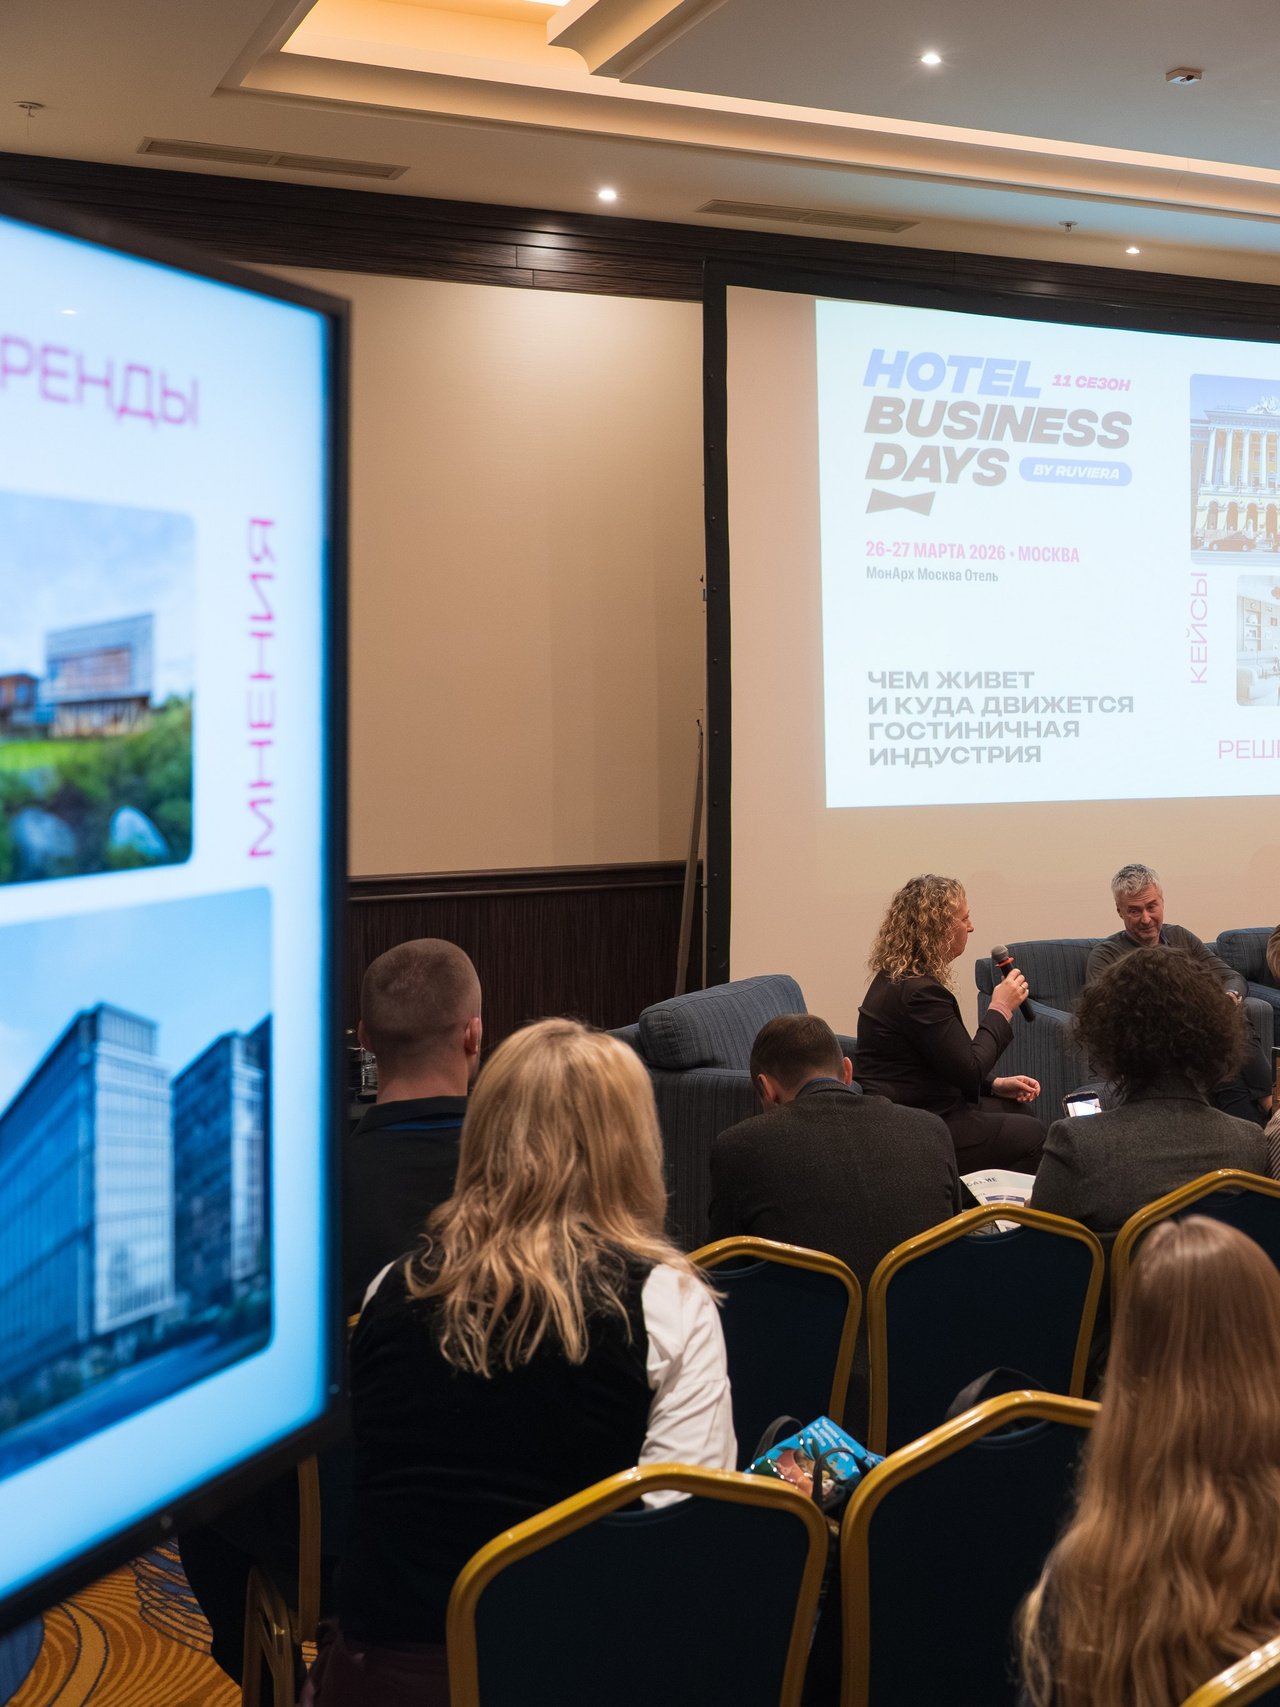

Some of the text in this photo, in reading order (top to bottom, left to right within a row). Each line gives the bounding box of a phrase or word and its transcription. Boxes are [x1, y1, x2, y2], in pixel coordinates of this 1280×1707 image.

[863, 348, 1041, 399] HOTEL
[1052, 374, 1131, 391] 11 СЕЗОН
[864, 395, 1132, 449] BUSINESS
[865, 442, 1010, 487] DAYS
[1032, 464, 1120, 480] BY RUVIERA
[913, 542, 966, 560] МАРТА
[969, 544, 1006, 561] 2026
[1018, 546, 1080, 563] МОСКВА
[866, 566, 999, 582] МонАрх Москва Отель
[1185, 572, 1208, 684] КЕЙСЫ
[248, 516, 275, 860] МНЕНИЯ
[868, 671, 1035, 689] ЧЕМ ЖИВЕТ
[868, 696, 1135, 717] И КУДА ДВИЖЕТСЯ
[868, 720, 1080, 740] ГОСТИНИЧНАЯ
[869, 745, 1042, 768] ИНДУСТРИЯ
